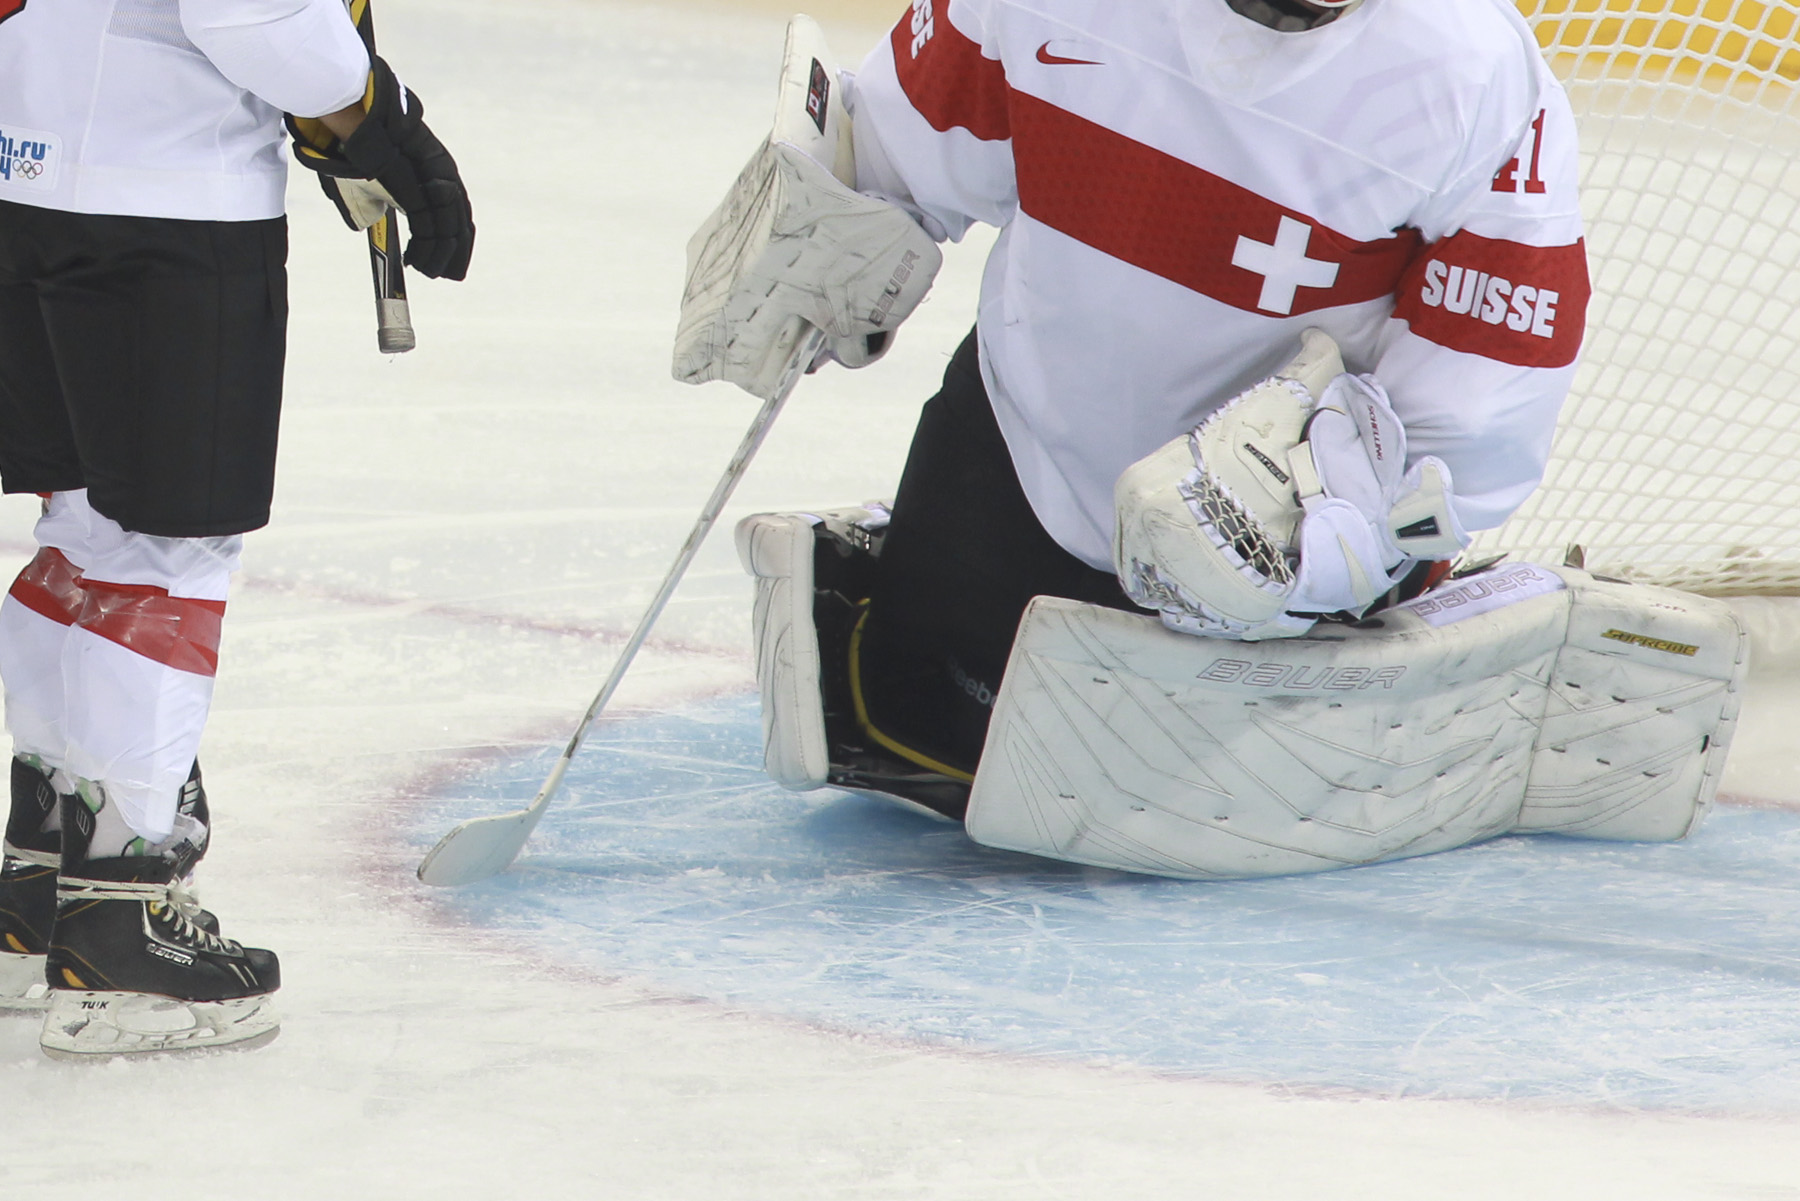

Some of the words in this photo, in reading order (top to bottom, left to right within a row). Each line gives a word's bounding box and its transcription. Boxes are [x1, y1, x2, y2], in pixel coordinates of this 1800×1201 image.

[868, 250, 920, 327] BAUER
[1421, 258, 1559, 339] SUISSE
[1408, 566, 1545, 617] BAUER
[1196, 657, 1407, 691] BAUER
